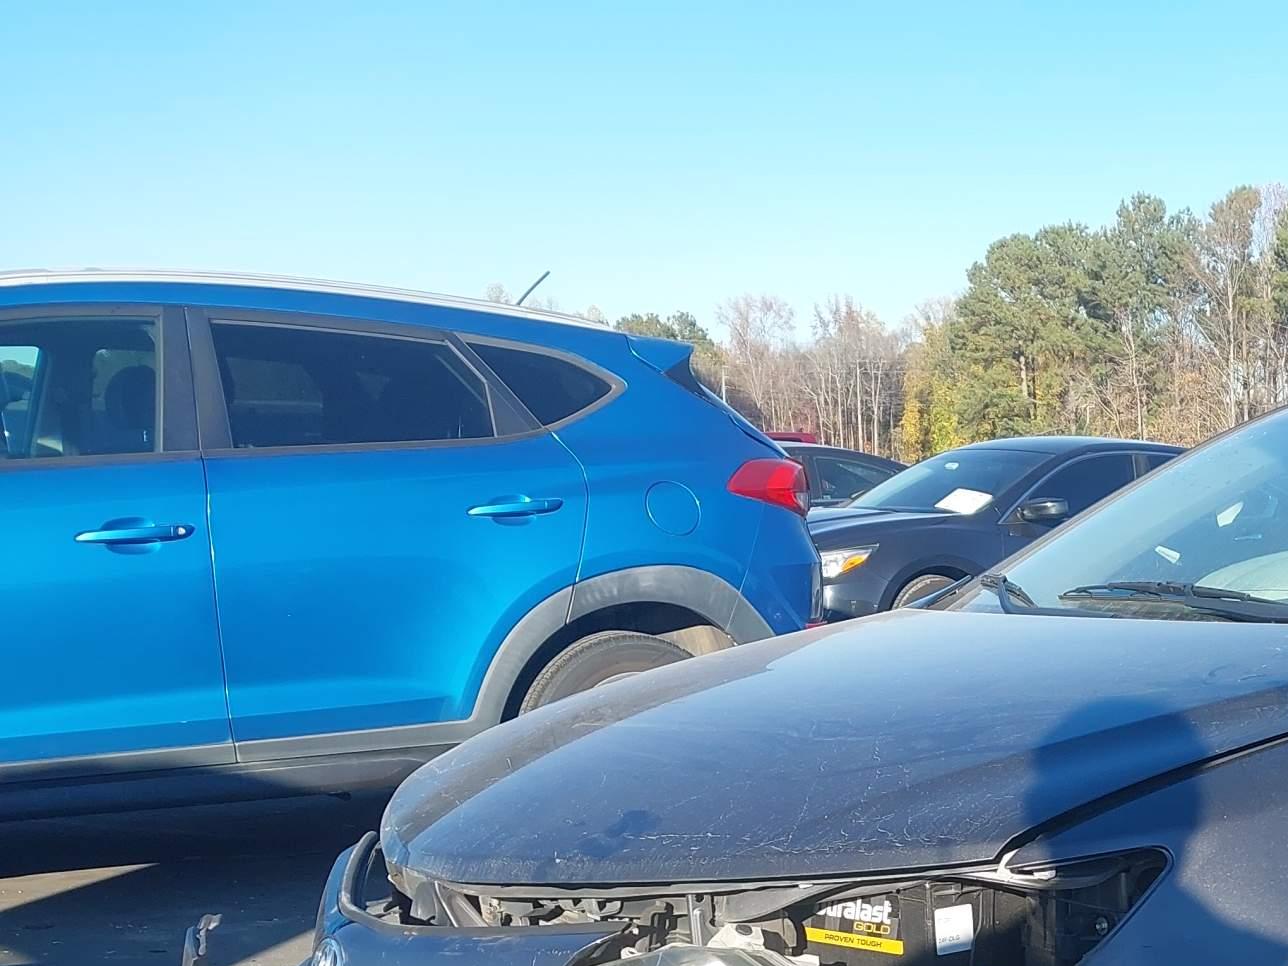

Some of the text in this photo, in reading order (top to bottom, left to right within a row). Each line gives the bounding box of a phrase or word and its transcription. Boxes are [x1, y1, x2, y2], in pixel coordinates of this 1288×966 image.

[853, 921, 890, 935] GOLD
[824, 933, 882, 948] PROVEN TOUGH
